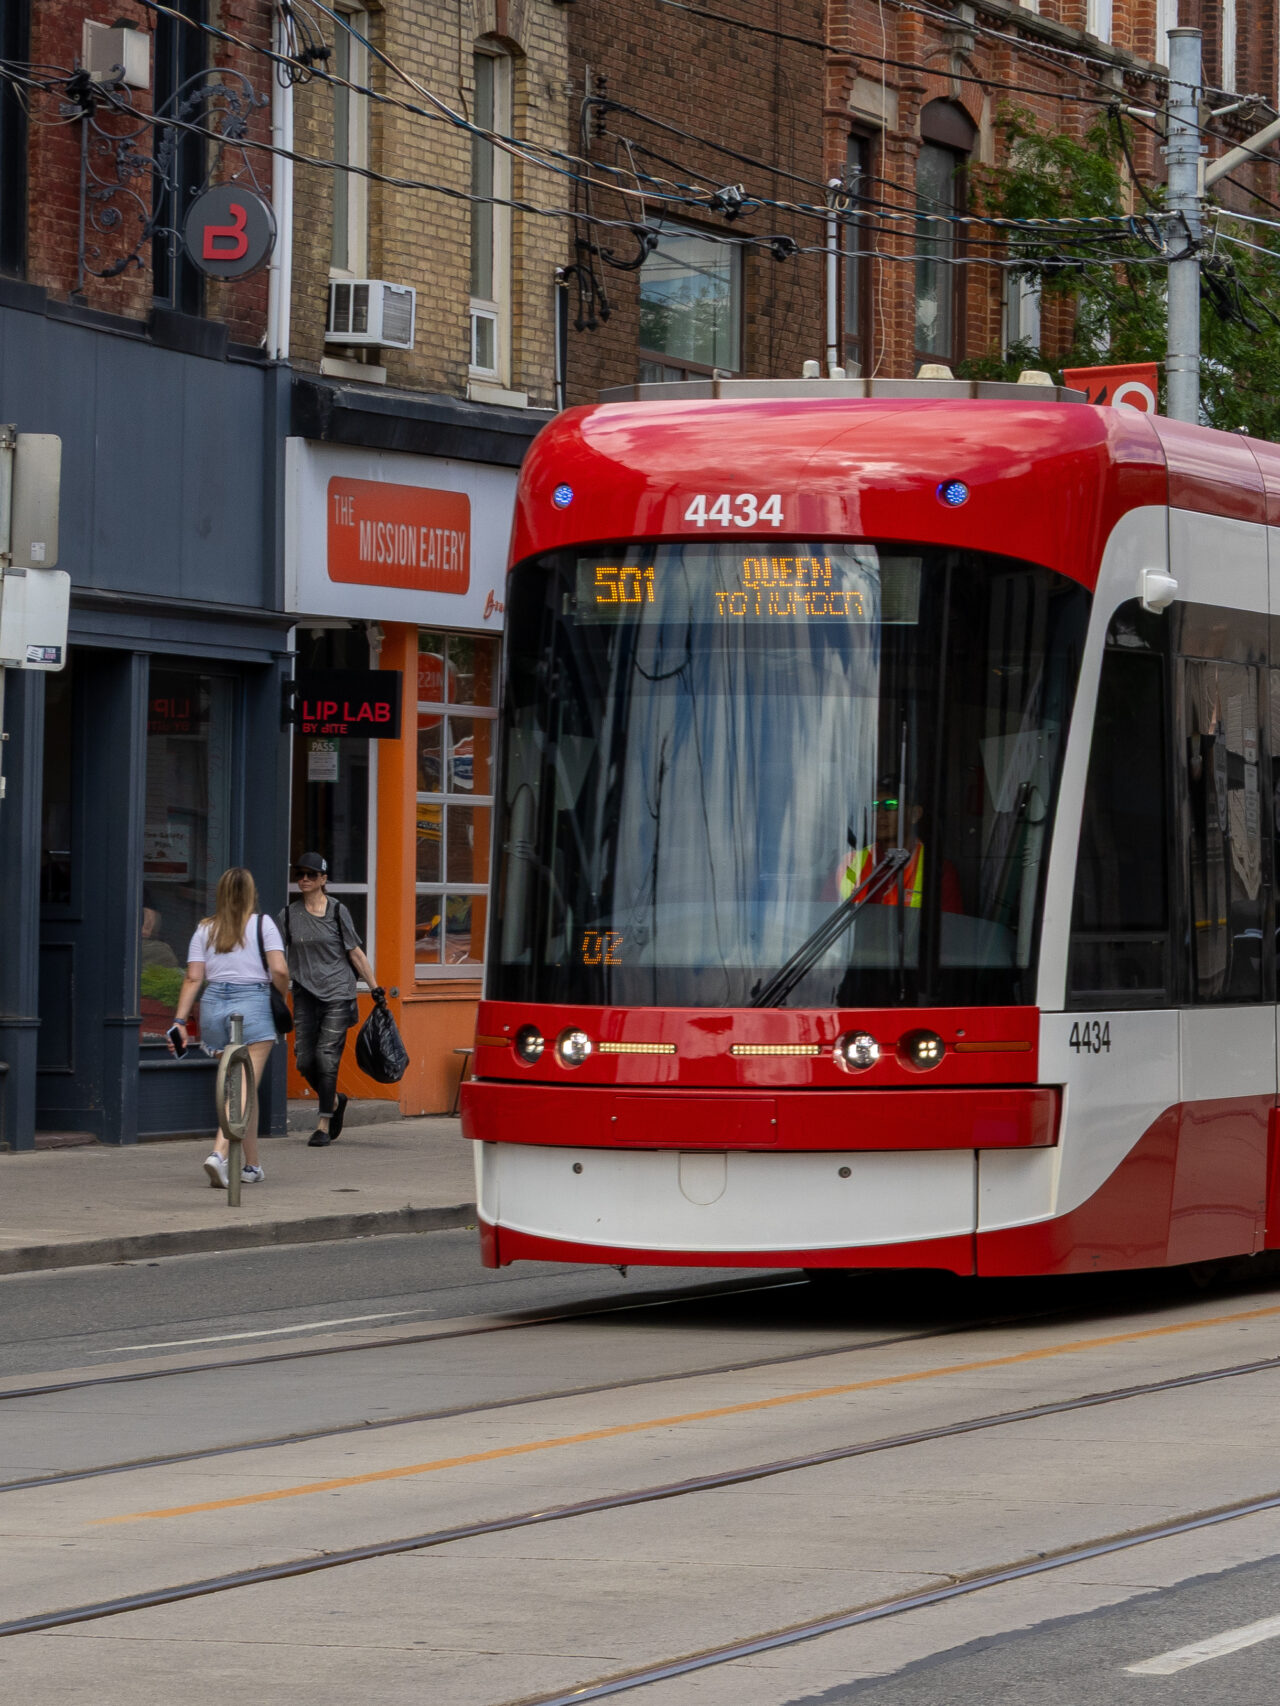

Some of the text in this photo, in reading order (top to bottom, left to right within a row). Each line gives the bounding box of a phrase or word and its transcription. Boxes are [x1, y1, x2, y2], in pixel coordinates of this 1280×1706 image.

[334, 494, 355, 526] THE
[684, 494, 784, 527] 4434
[359, 519, 466, 573] MISSION EATERY
[594, 567, 655, 602] 501
[742, 557, 832, 589] QUEEN
[715, 592, 748, 615] TO
[302, 700, 391, 722] LIP LAB
[302, 722, 319, 733] BY
[312, 742, 335, 751] PASS
[1069, 1020, 1111, 1054] 4434
